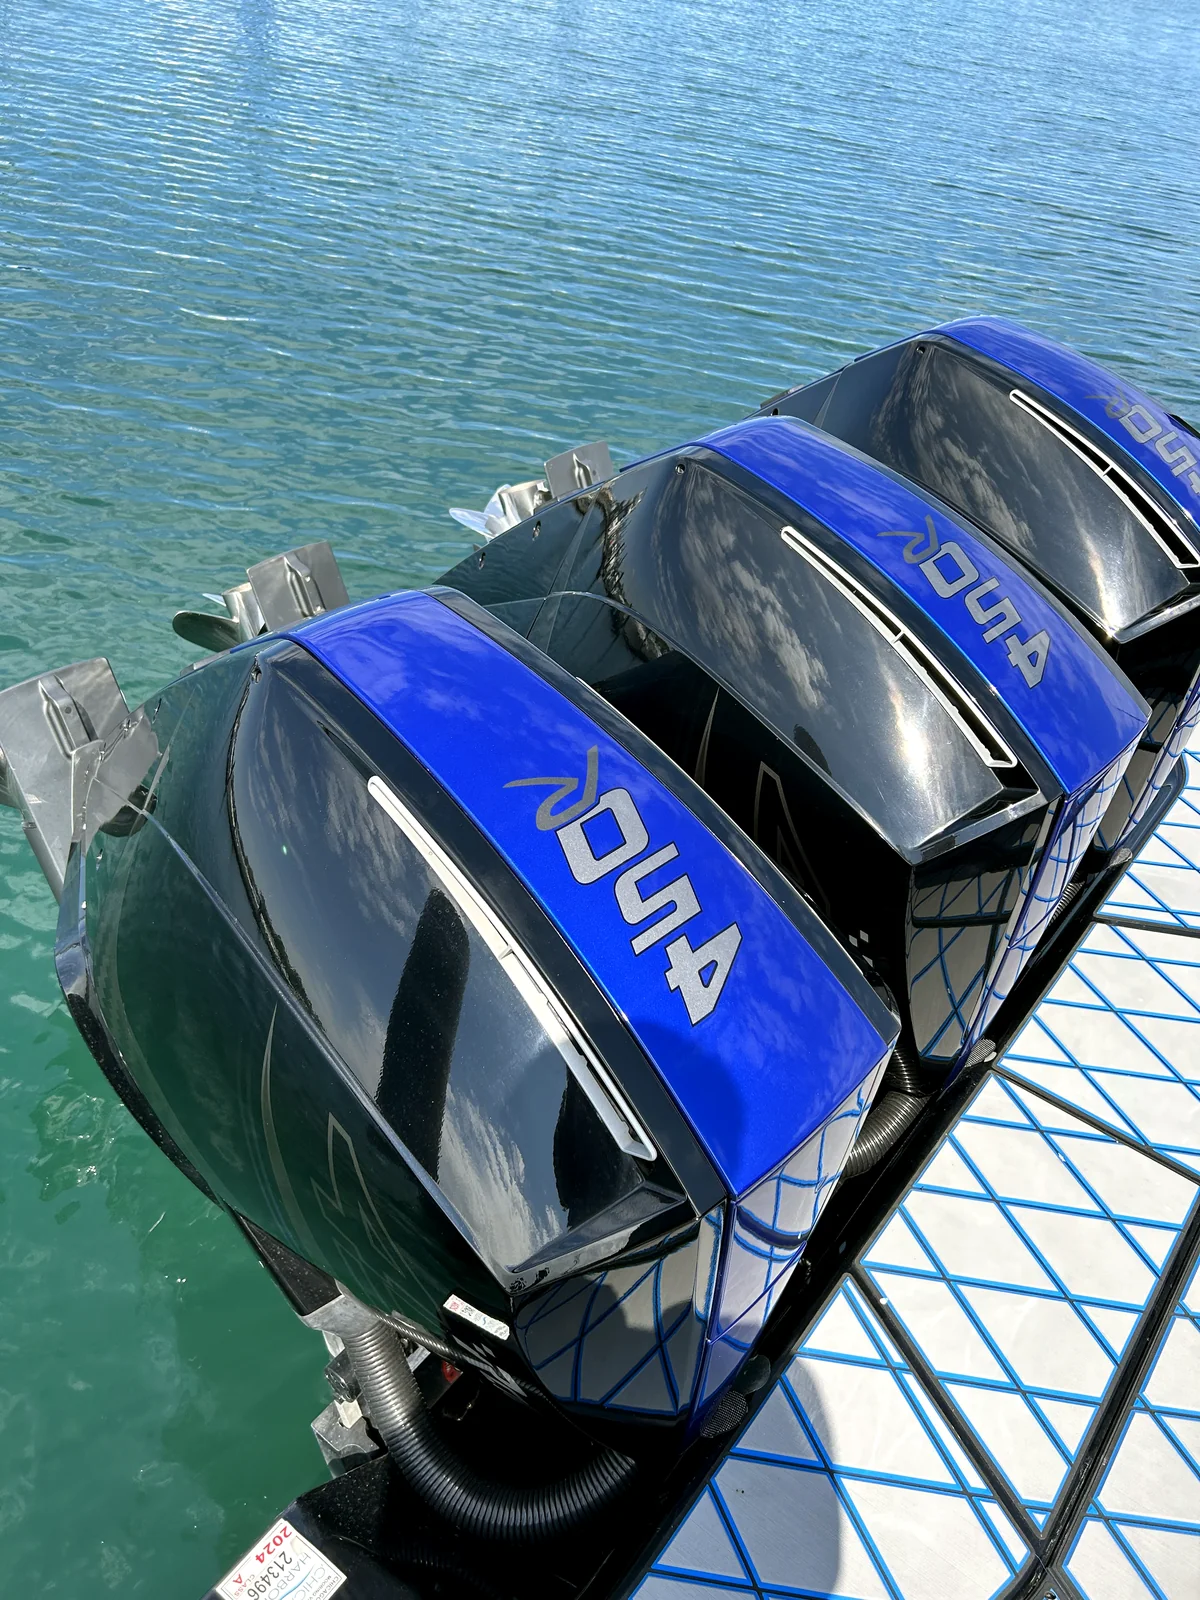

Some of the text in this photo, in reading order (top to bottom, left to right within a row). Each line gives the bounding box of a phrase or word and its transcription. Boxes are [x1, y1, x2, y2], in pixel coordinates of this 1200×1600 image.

[876, 514, 1051, 689] 450R
[502, 744, 743, 1027] 450R
[233, 1574, 243, 1584] A
[234, 1526, 292, 1597] 2024 CLASS
[247, 1551, 292, 1600] 213496
[264, 1553, 311, 1600] HARBO
[292, 1567, 325, 1600] CHIC
